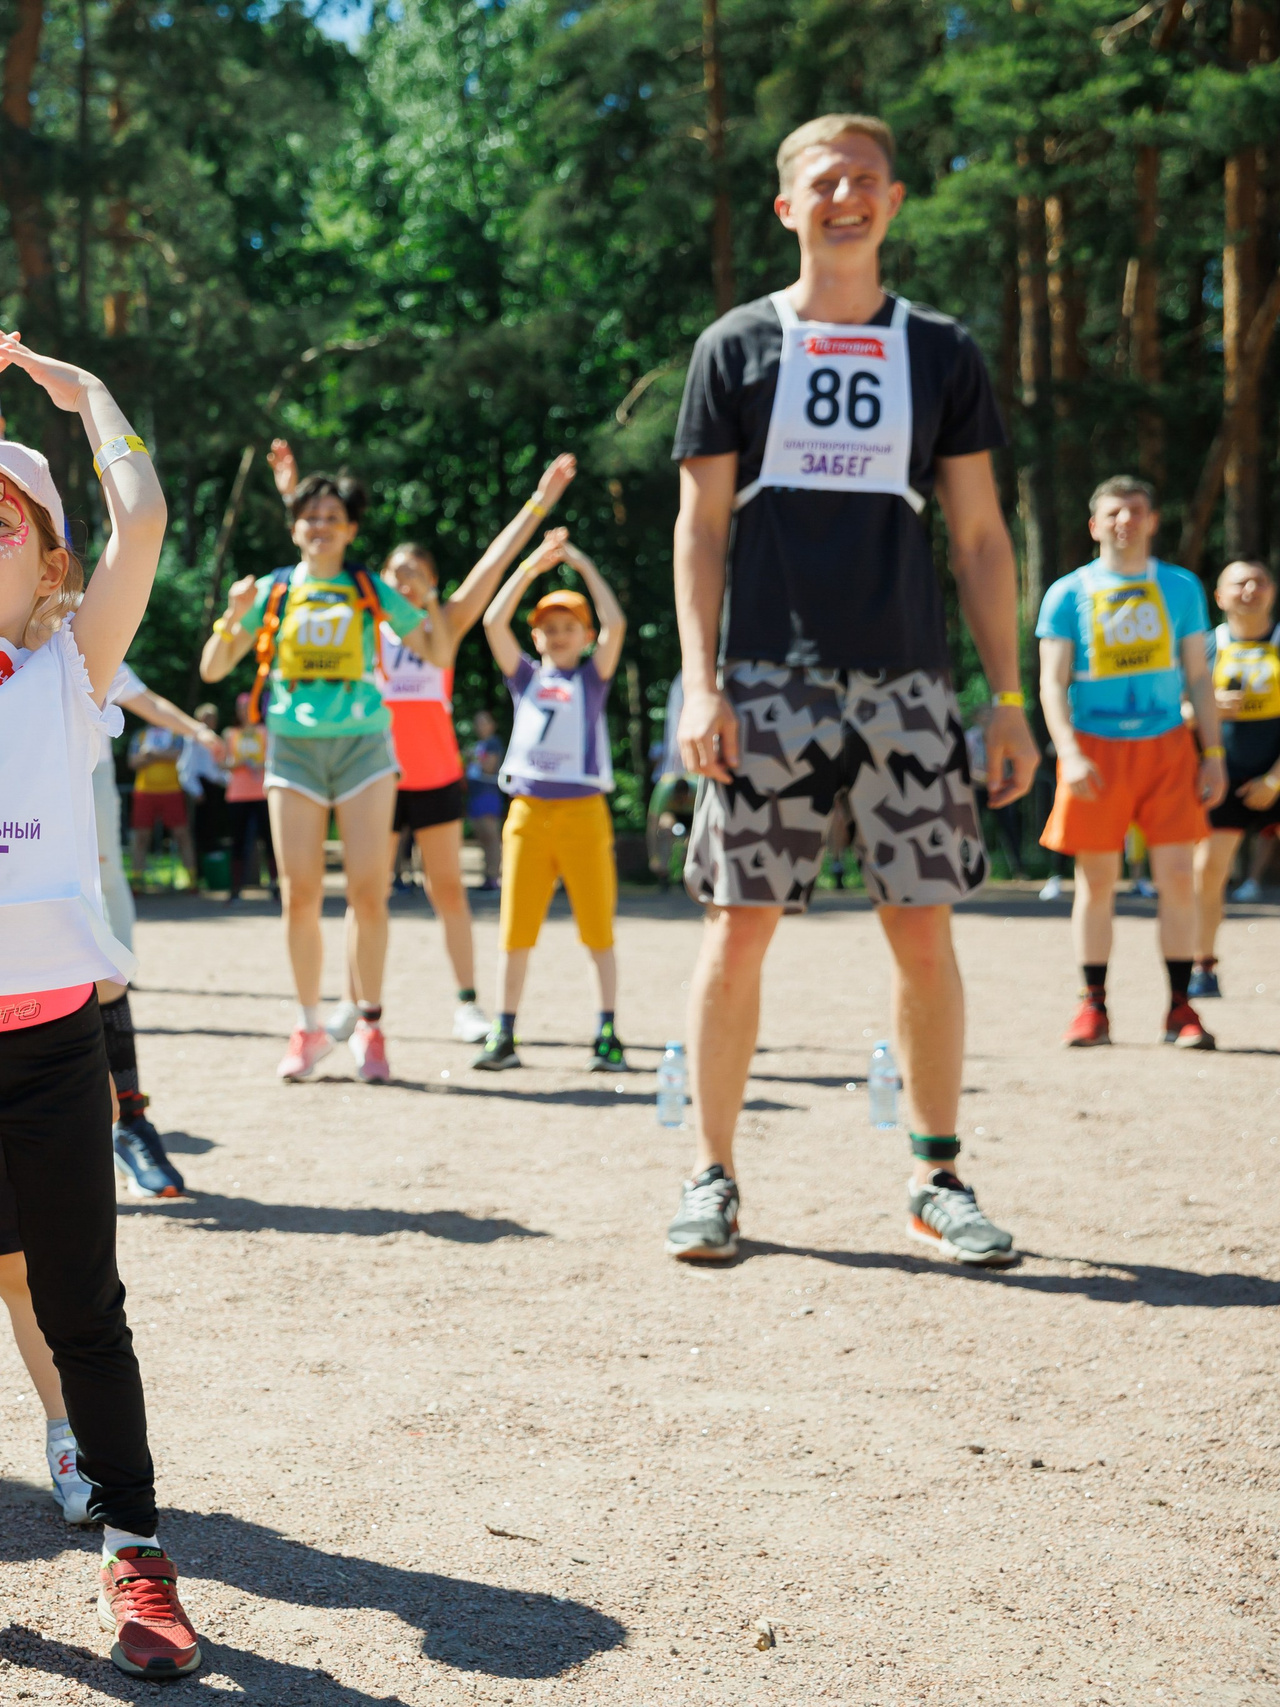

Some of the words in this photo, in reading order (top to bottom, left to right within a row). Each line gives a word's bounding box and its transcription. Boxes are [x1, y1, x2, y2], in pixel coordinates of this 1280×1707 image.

[806, 367, 881, 429] 86
[802, 454, 873, 477] ЗАБЕГ
[294, 605, 353, 647] 167
[1096, 601, 1161, 647] 168
[539, 706, 556, 743] 7
